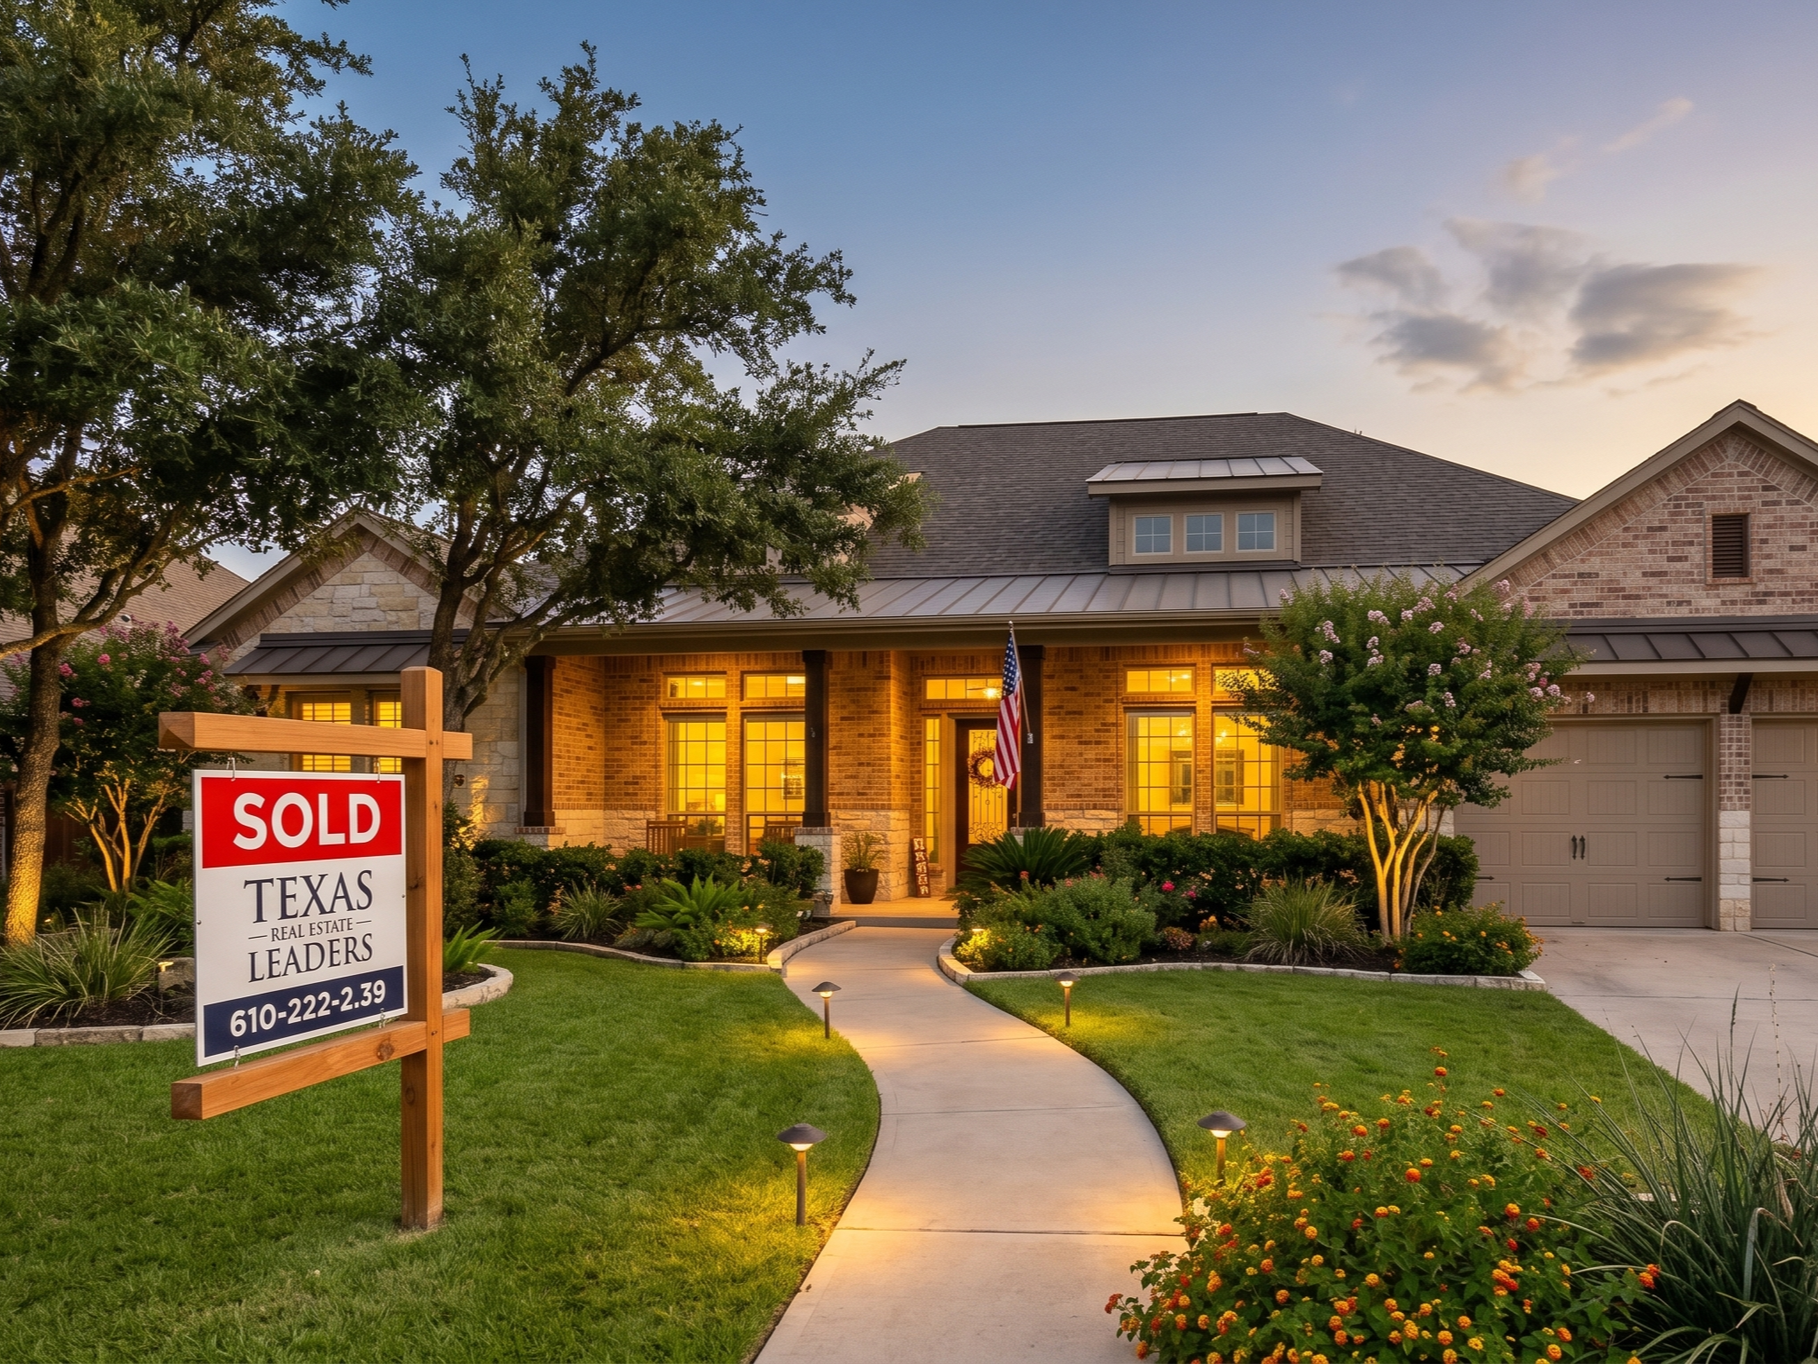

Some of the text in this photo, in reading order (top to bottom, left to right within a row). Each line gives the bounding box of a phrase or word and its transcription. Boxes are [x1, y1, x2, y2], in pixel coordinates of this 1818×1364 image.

[232, 792, 381, 850] SOLD
[243, 869, 373, 924] TEXAS
[271, 917, 354, 942] REAL ESTATE
[247, 932, 373, 983] LEADERS
[230, 979, 386, 1037] 610-222-2.39
